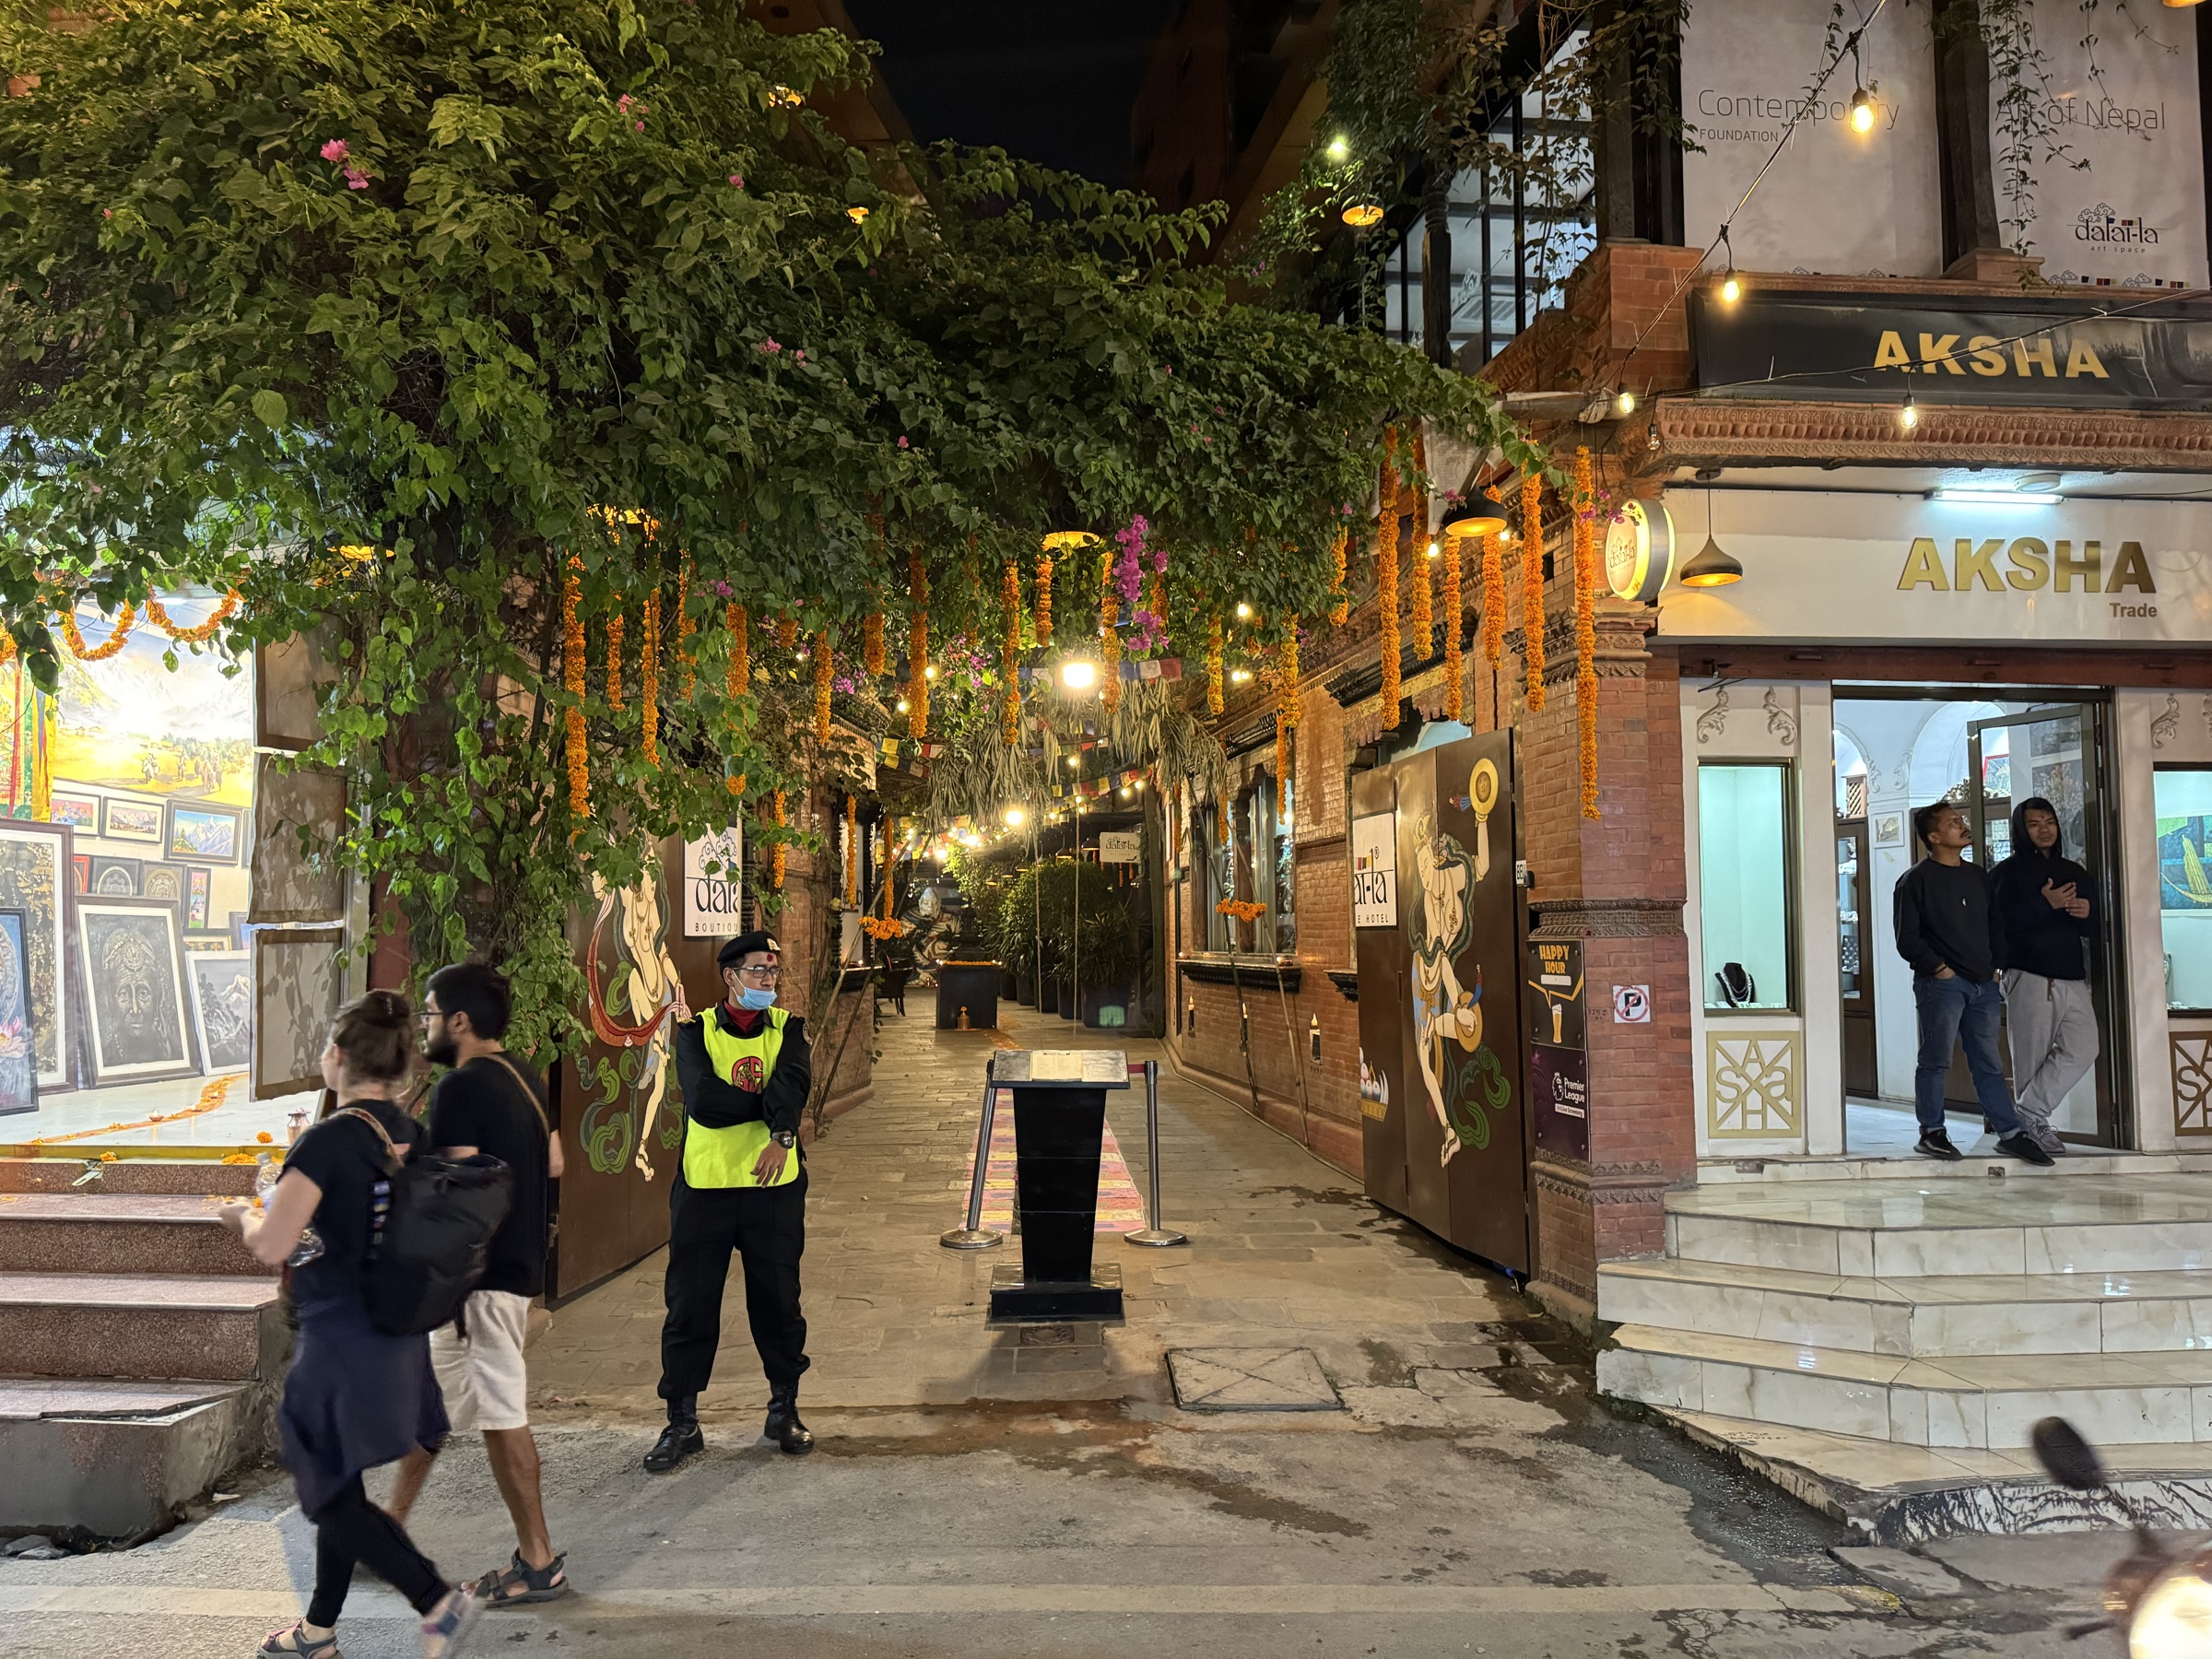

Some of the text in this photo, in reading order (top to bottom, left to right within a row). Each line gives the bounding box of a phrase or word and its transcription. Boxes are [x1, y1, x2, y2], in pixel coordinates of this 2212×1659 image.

[2048, 97, 2077, 124] of
[2087, 100, 2166, 135] Nepal
[1700, 128, 1779, 142] FOUNDATION
[2075, 215, 2159, 244] dalai-la
[1873, 330, 2111, 379] AKSHA
[1896, 536, 2158, 594] AKSHA
[2109, 602, 2159, 618] Trade
[1366, 913, 1389, 924] HOTEL
[1538, 945, 1570, 960] HAPPY
[1545, 961, 1566, 974] HOUR
[1564, 1077, 1584, 1091] Premier
[1564, 1088, 1585, 1104] League
